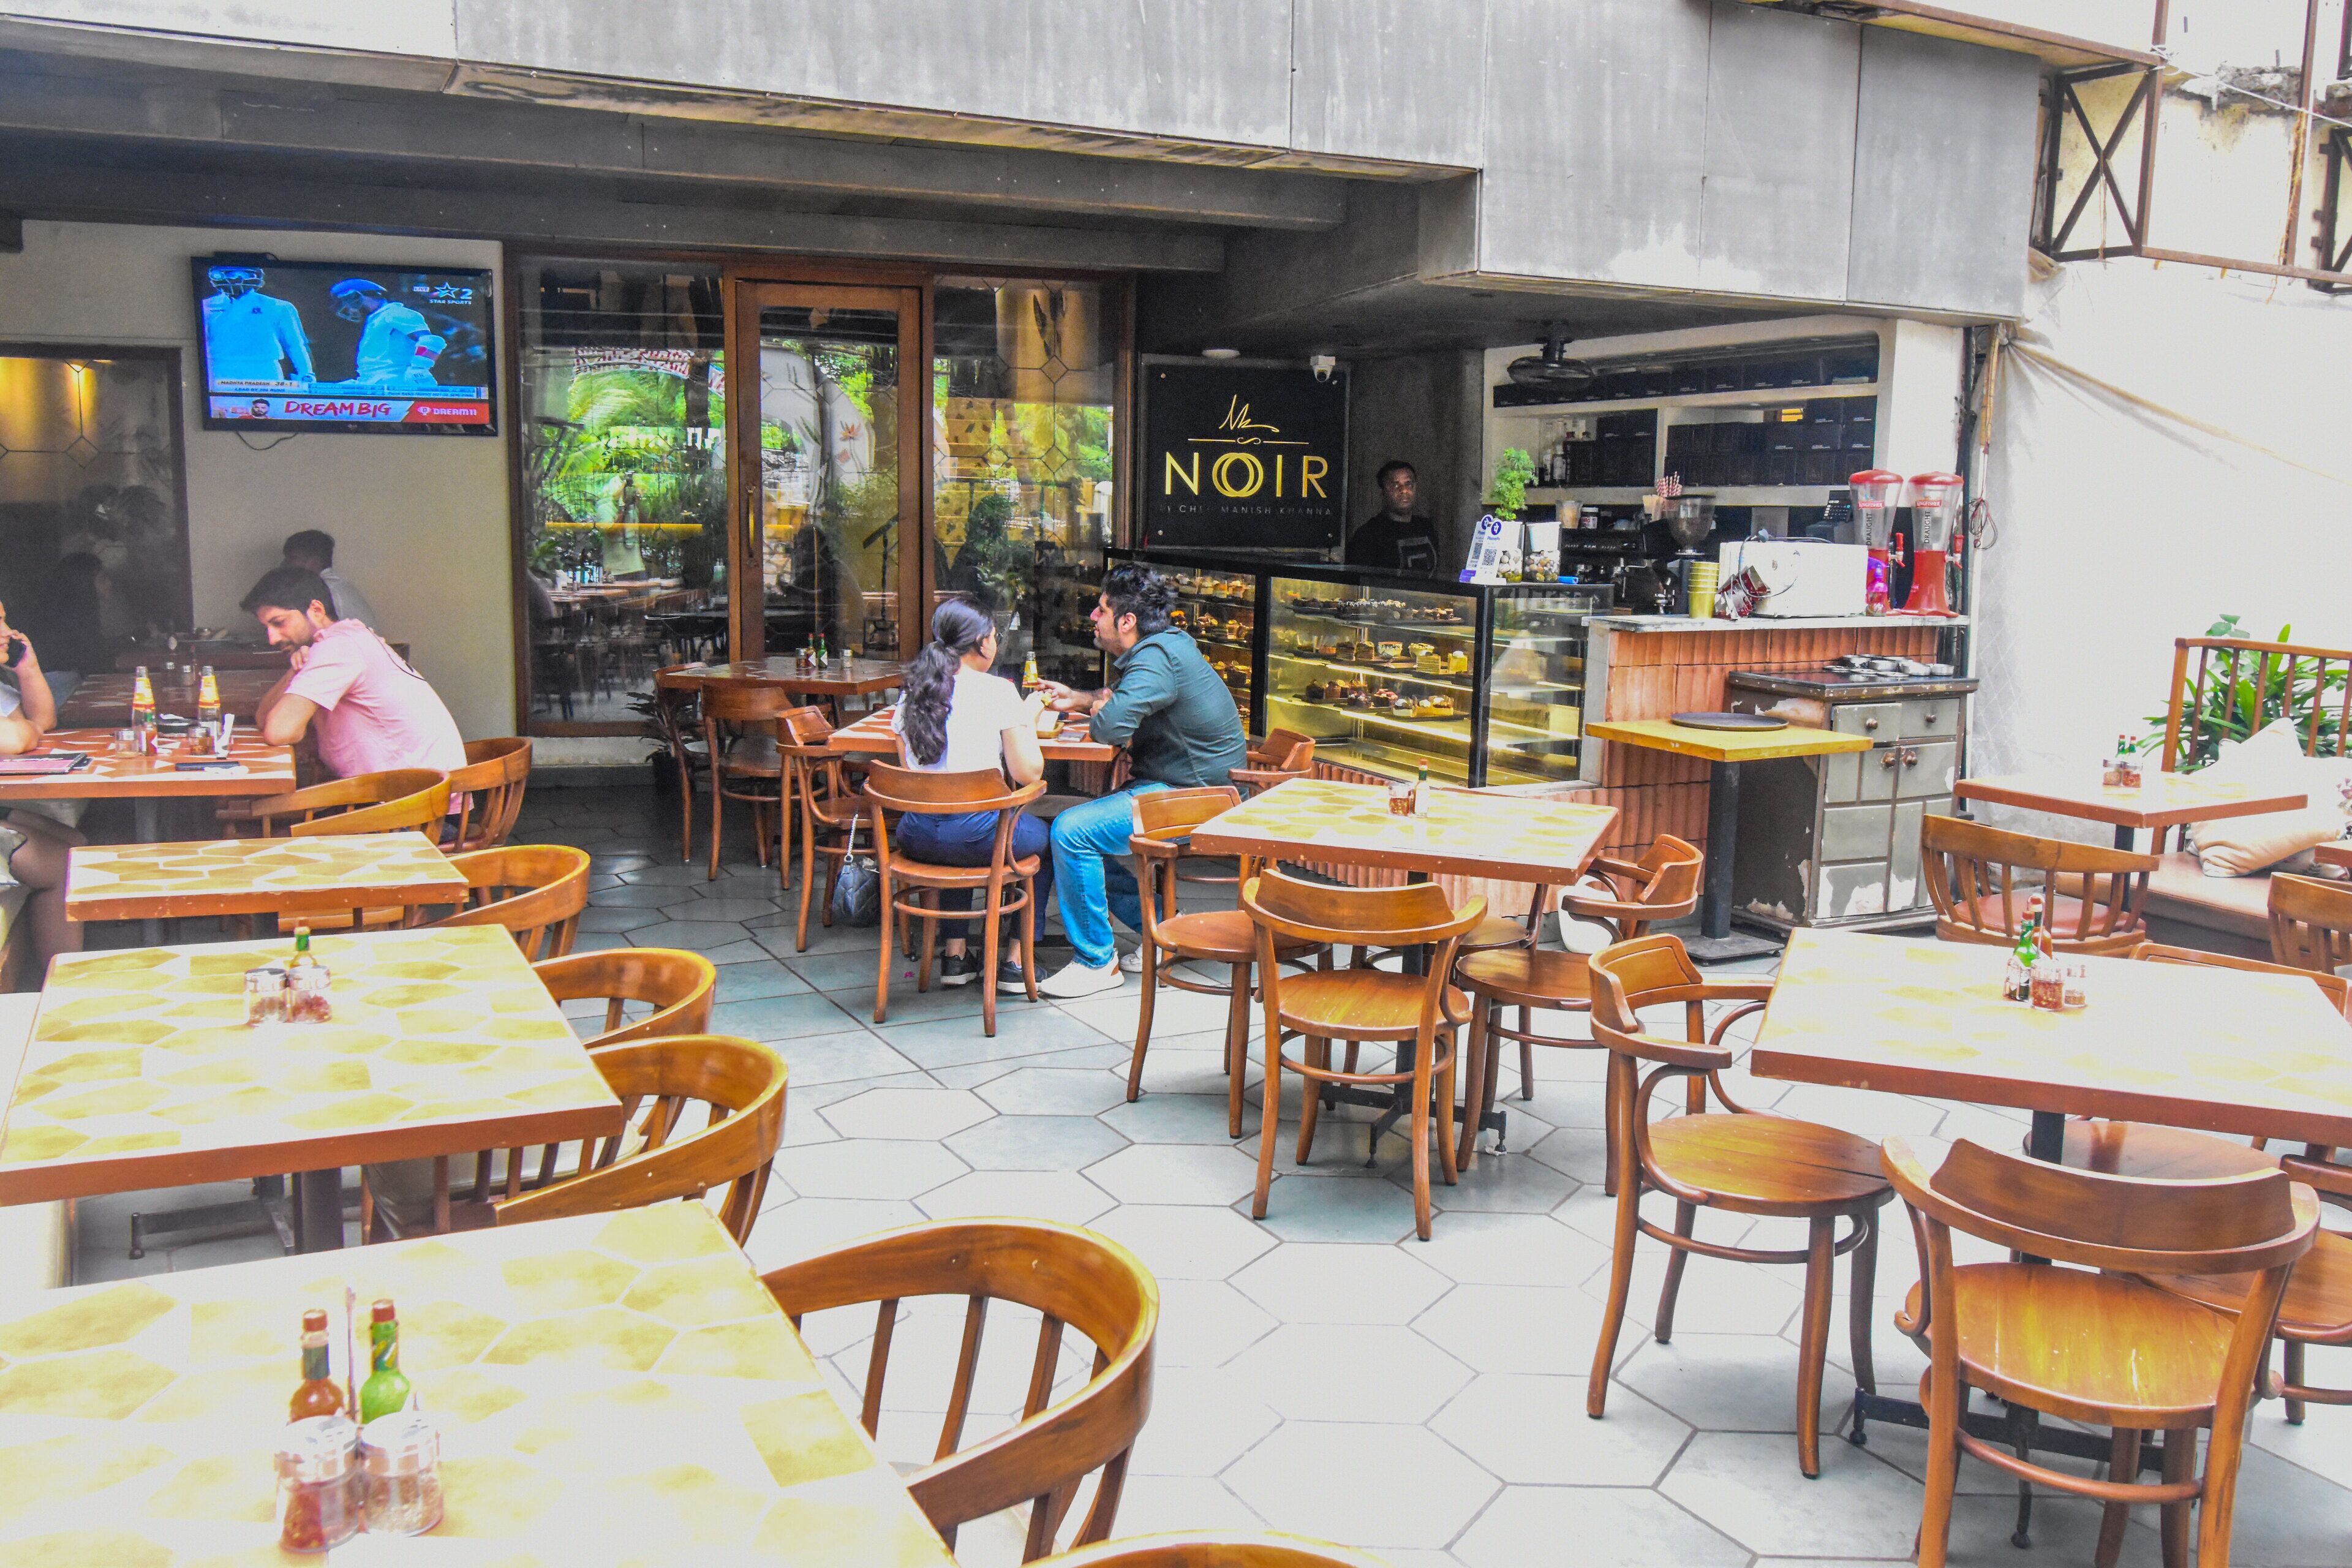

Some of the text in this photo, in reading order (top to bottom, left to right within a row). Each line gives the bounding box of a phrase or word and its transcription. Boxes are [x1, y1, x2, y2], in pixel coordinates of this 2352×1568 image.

[460, 288, 473, 300] 2
[284, 401, 392, 418] DREAM BIG
[433, 407, 477, 416] DREAM11
[1221, 506, 1272, 514] MANISH
